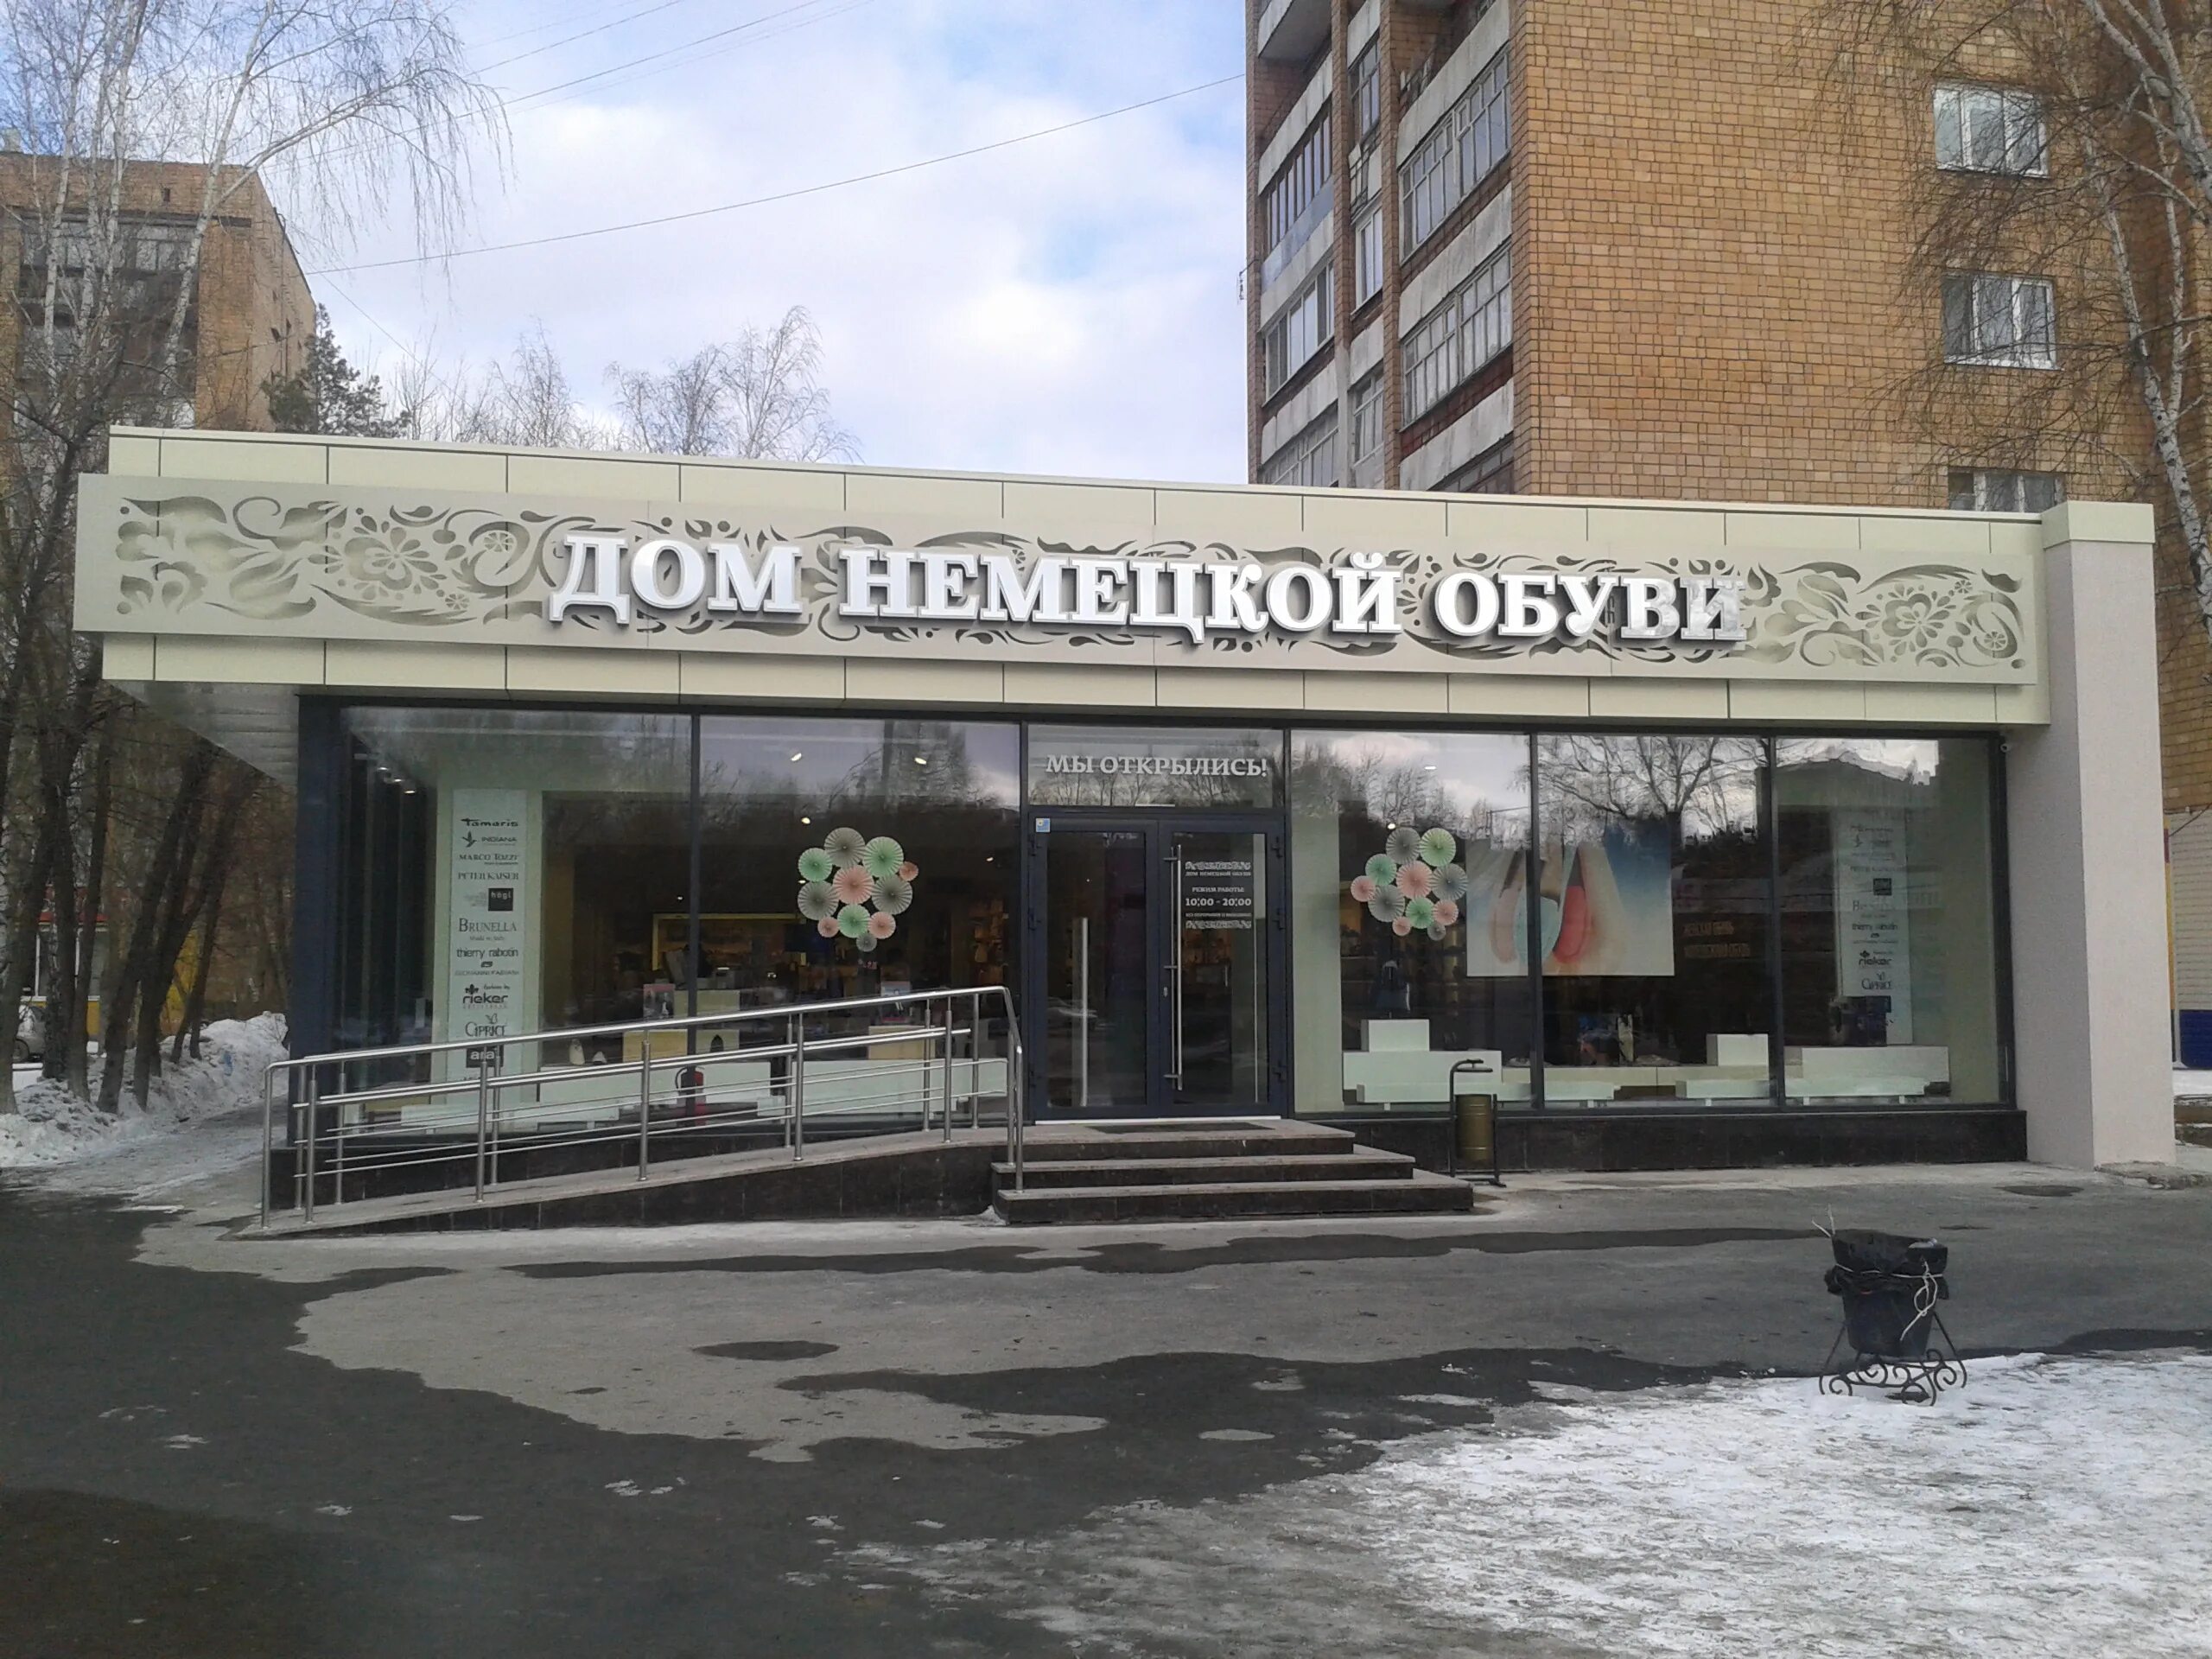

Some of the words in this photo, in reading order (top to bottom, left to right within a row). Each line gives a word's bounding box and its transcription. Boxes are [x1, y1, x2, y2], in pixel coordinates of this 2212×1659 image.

[549, 532, 802, 625] ДОМ
[837, 550, 1404, 643] НЕМЕЦКОЙ
[1433, 572, 1747, 641] ОБУВИ
[1046, 753, 1094, 773] МЫ
[1099, 755, 1268, 777] ОТКРЫЛИСЬ!
[461, 817, 518, 827] Tamaris
[1185, 898, 1214, 906] 10:00
[1222, 898, 1252, 906] 20:00
[459, 918, 518, 932] BRUNELLA
[456, 948, 486, 959] thierry
[488, 947, 519, 957] rabotin
[462, 992, 508, 1003] rieker
